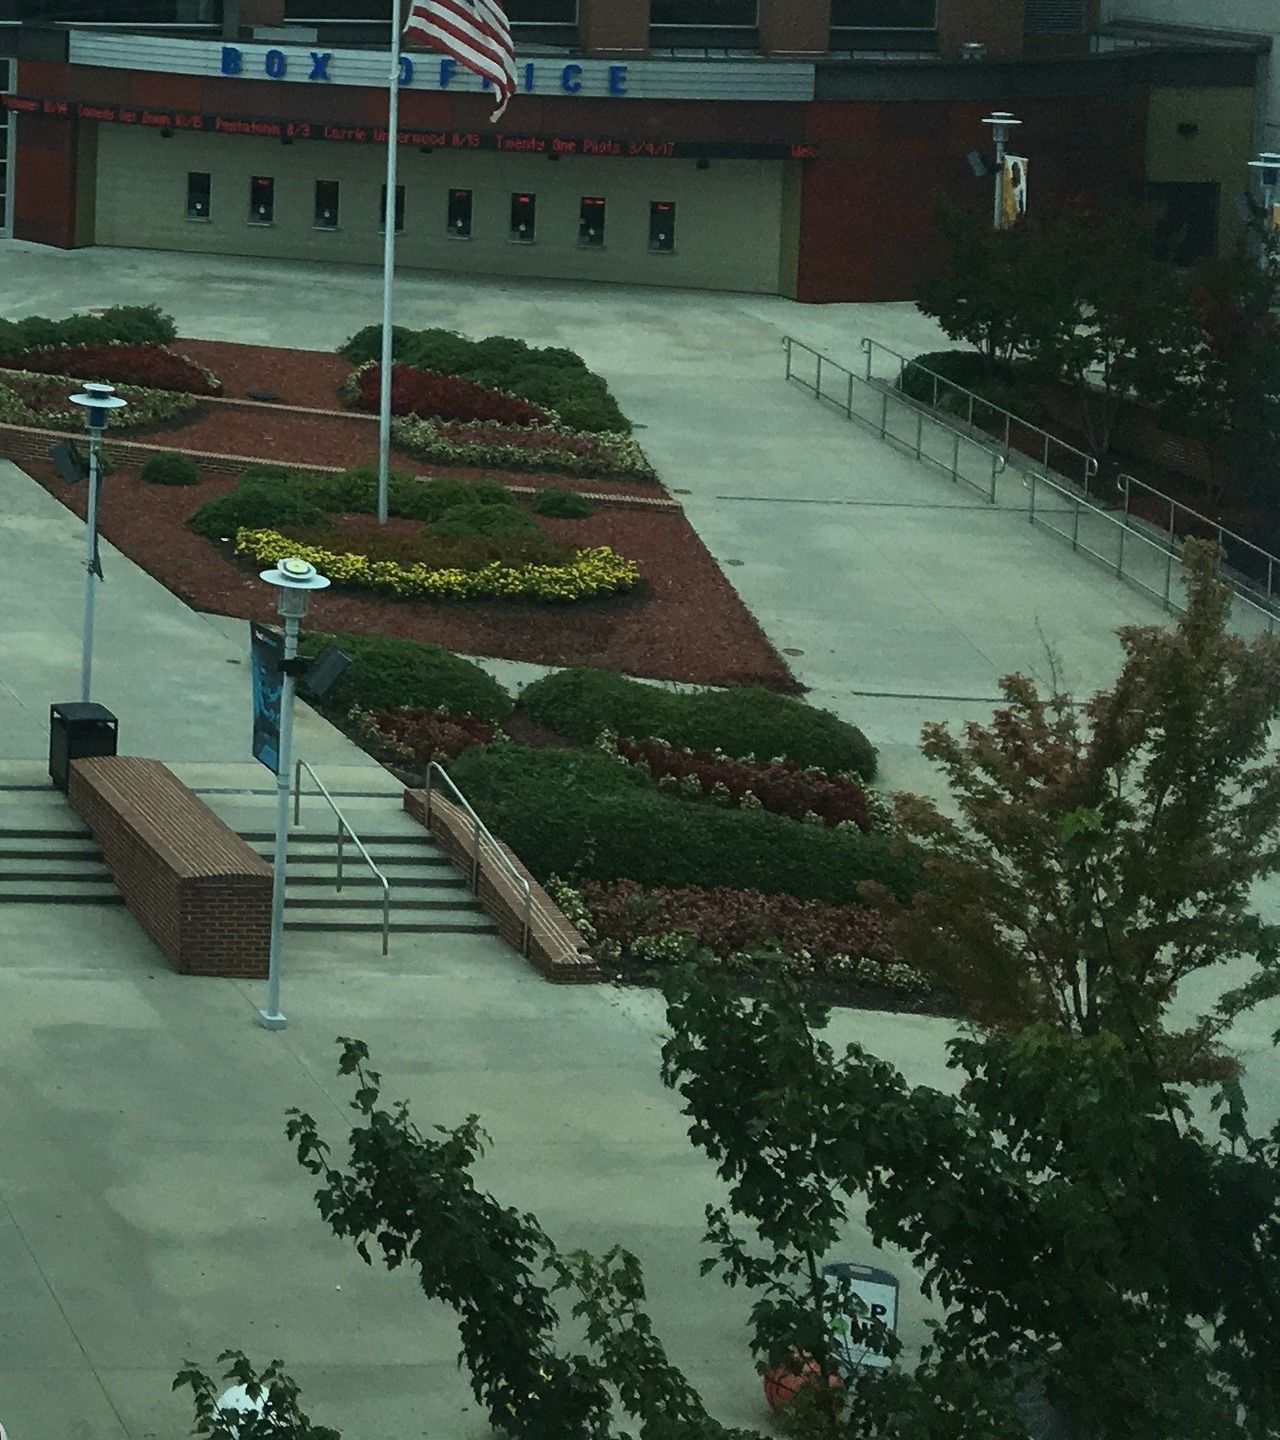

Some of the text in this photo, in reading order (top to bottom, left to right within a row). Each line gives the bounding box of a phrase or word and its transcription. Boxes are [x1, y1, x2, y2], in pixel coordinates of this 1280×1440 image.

[220, 46, 630, 95] BOX OFICE
[373, 128, 446, 145] Unerwood
